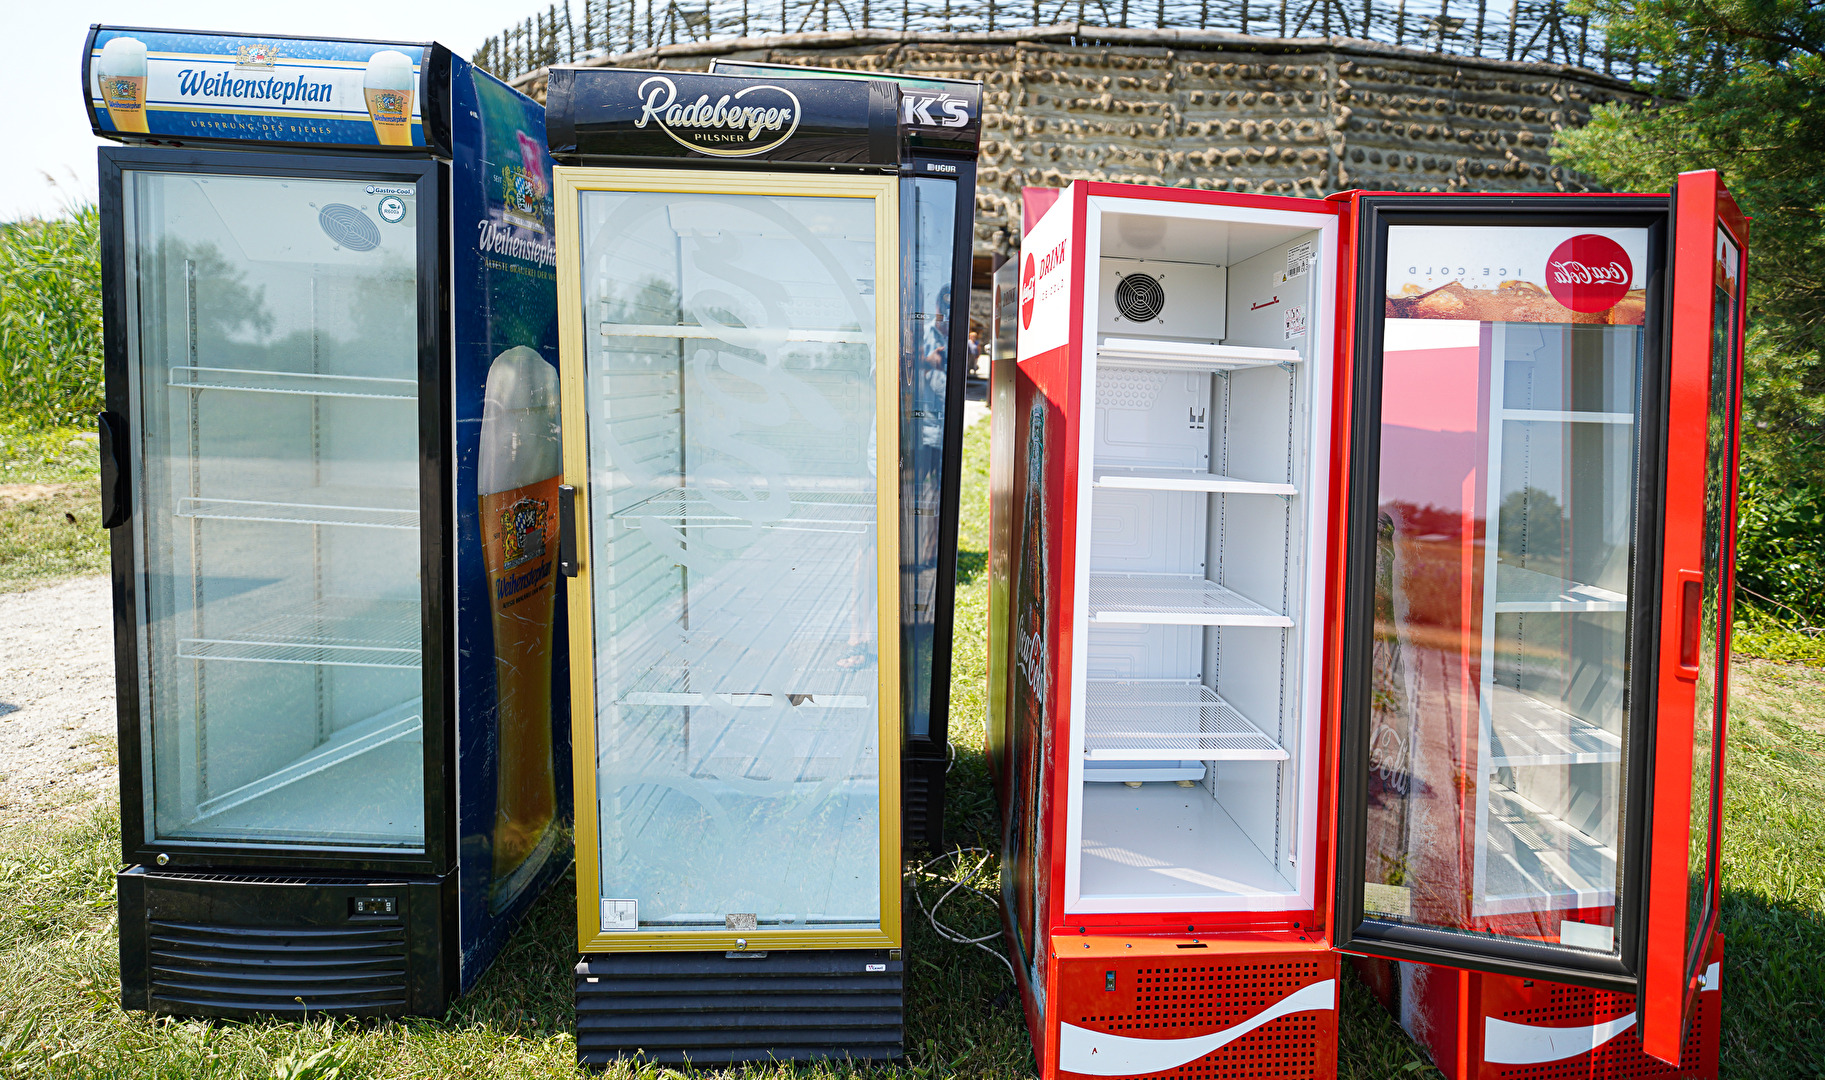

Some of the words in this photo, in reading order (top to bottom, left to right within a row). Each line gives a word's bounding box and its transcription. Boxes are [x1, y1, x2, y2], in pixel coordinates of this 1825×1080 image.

[177, 69, 333, 105] Weihenstephan
[634, 76, 791, 141] Radeberger
[190, 120, 255, 131] URSPRUNG
[262, 124, 284, 132] DES
[290, 125, 332, 134] BIERES
[694, 133, 745, 143] PILSNER
[935, 164, 957, 173] UGUR
[1038, 237, 1068, 280] DRINK
